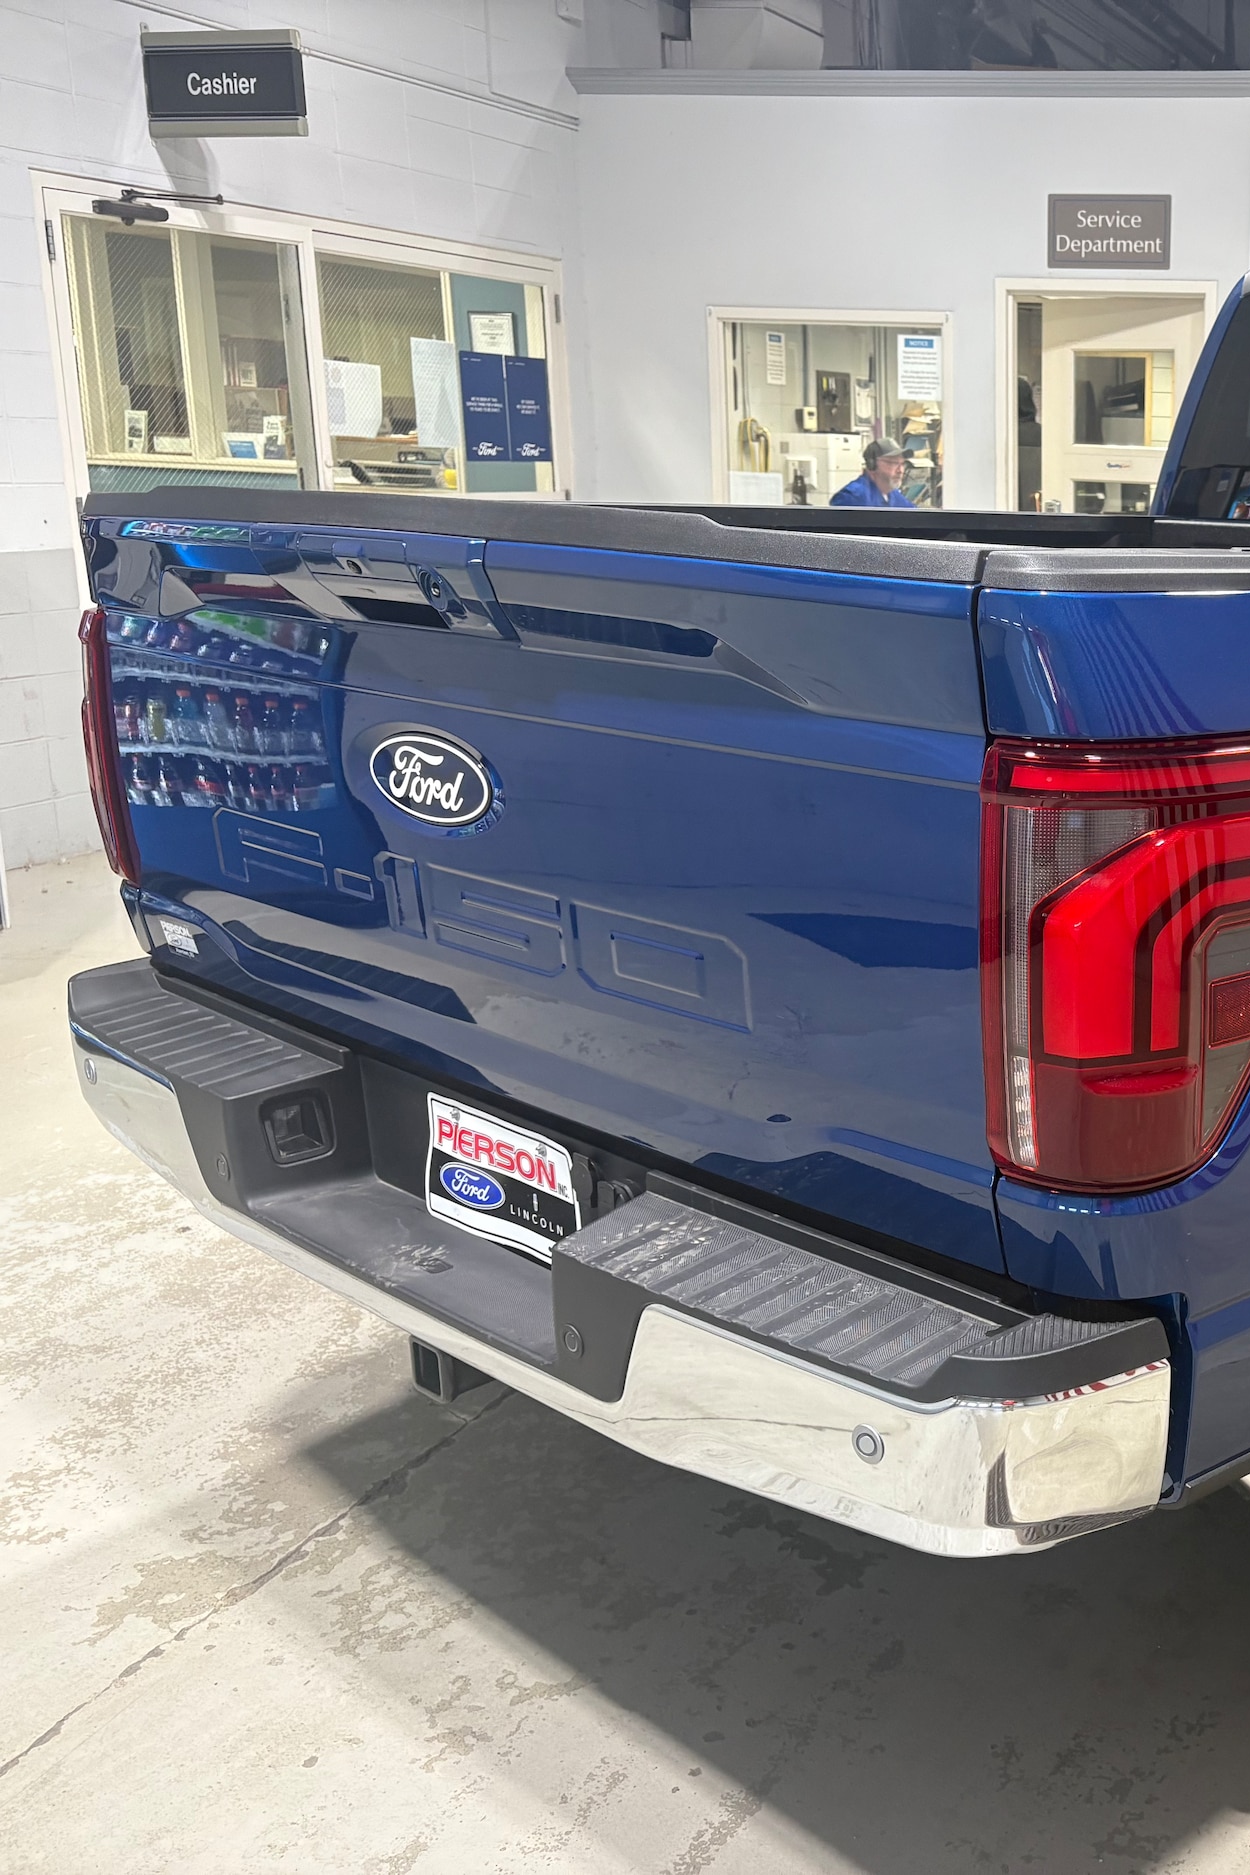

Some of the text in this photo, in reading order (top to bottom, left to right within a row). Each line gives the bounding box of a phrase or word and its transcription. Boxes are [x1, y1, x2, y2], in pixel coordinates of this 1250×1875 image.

[187, 72, 257, 96] Cashier
[1077, 210, 1142, 228] Service
[1056, 234, 1163, 258] Department
[478, 442, 498, 457] Ford
[521, 443, 541, 457] Ford
[389, 745, 465, 812] Ford
[212, 806, 754, 1034] F-150
[437, 1115, 570, 1199] PIERSON INC.
[451, 1169, 491, 1202] Ford
[510, 1204, 564, 1236] LINCOLN
